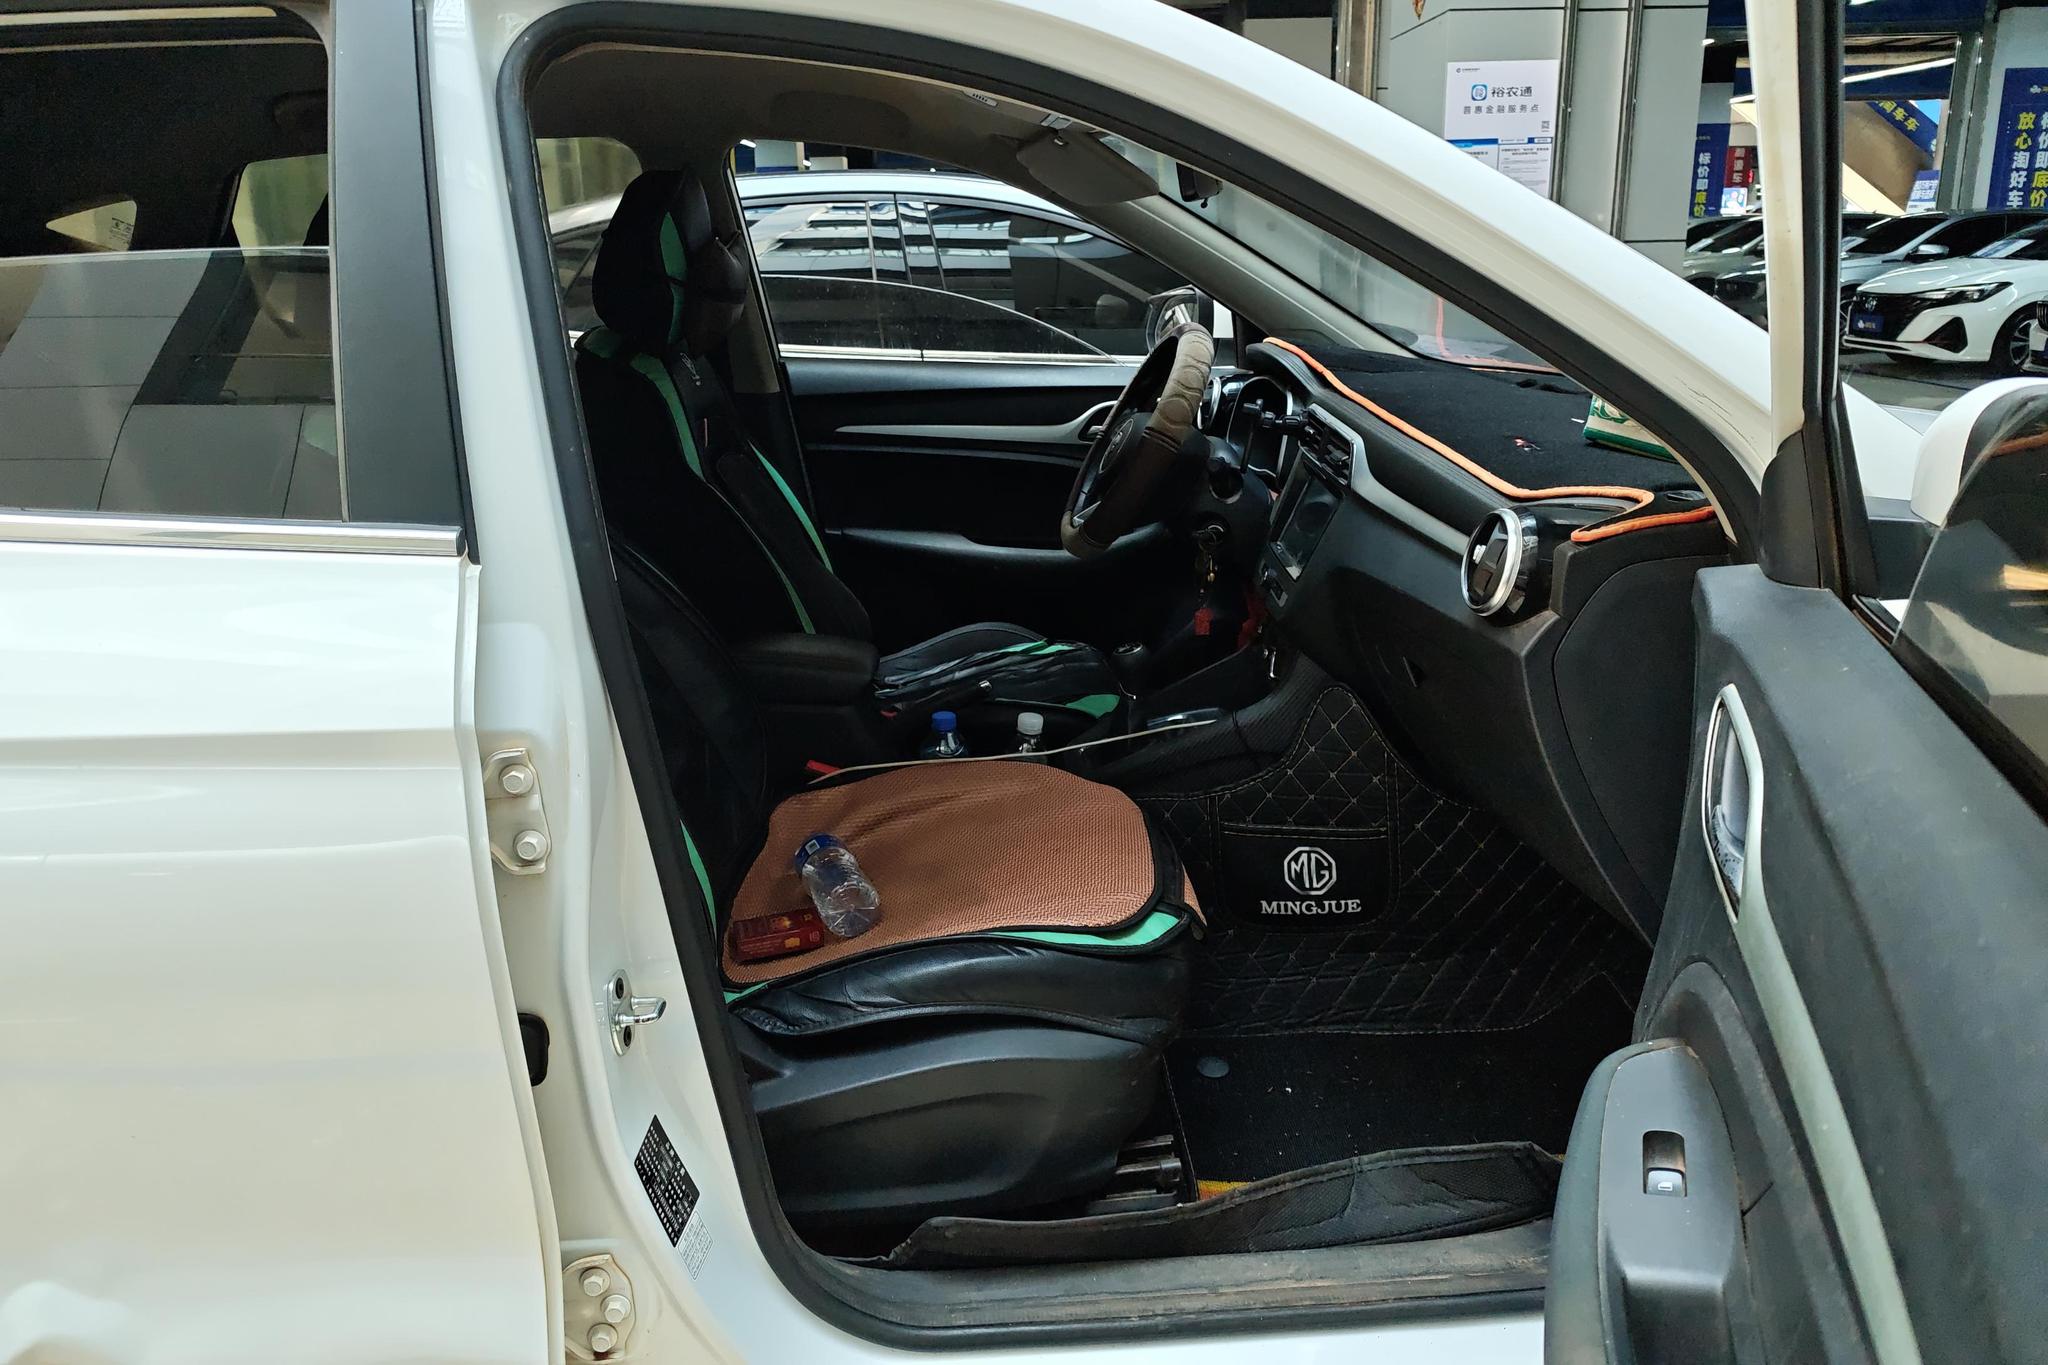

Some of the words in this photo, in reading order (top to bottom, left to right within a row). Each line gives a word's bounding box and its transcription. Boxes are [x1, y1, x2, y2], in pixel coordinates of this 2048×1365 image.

[1491, 86, 1532, 97] 裕农通
[1464, 104, 1539, 114] 普惠金融服务点
[2006, 111, 2036, 208] 放心淘好车
[1260, 899, 1362, 915] MINGJUE
